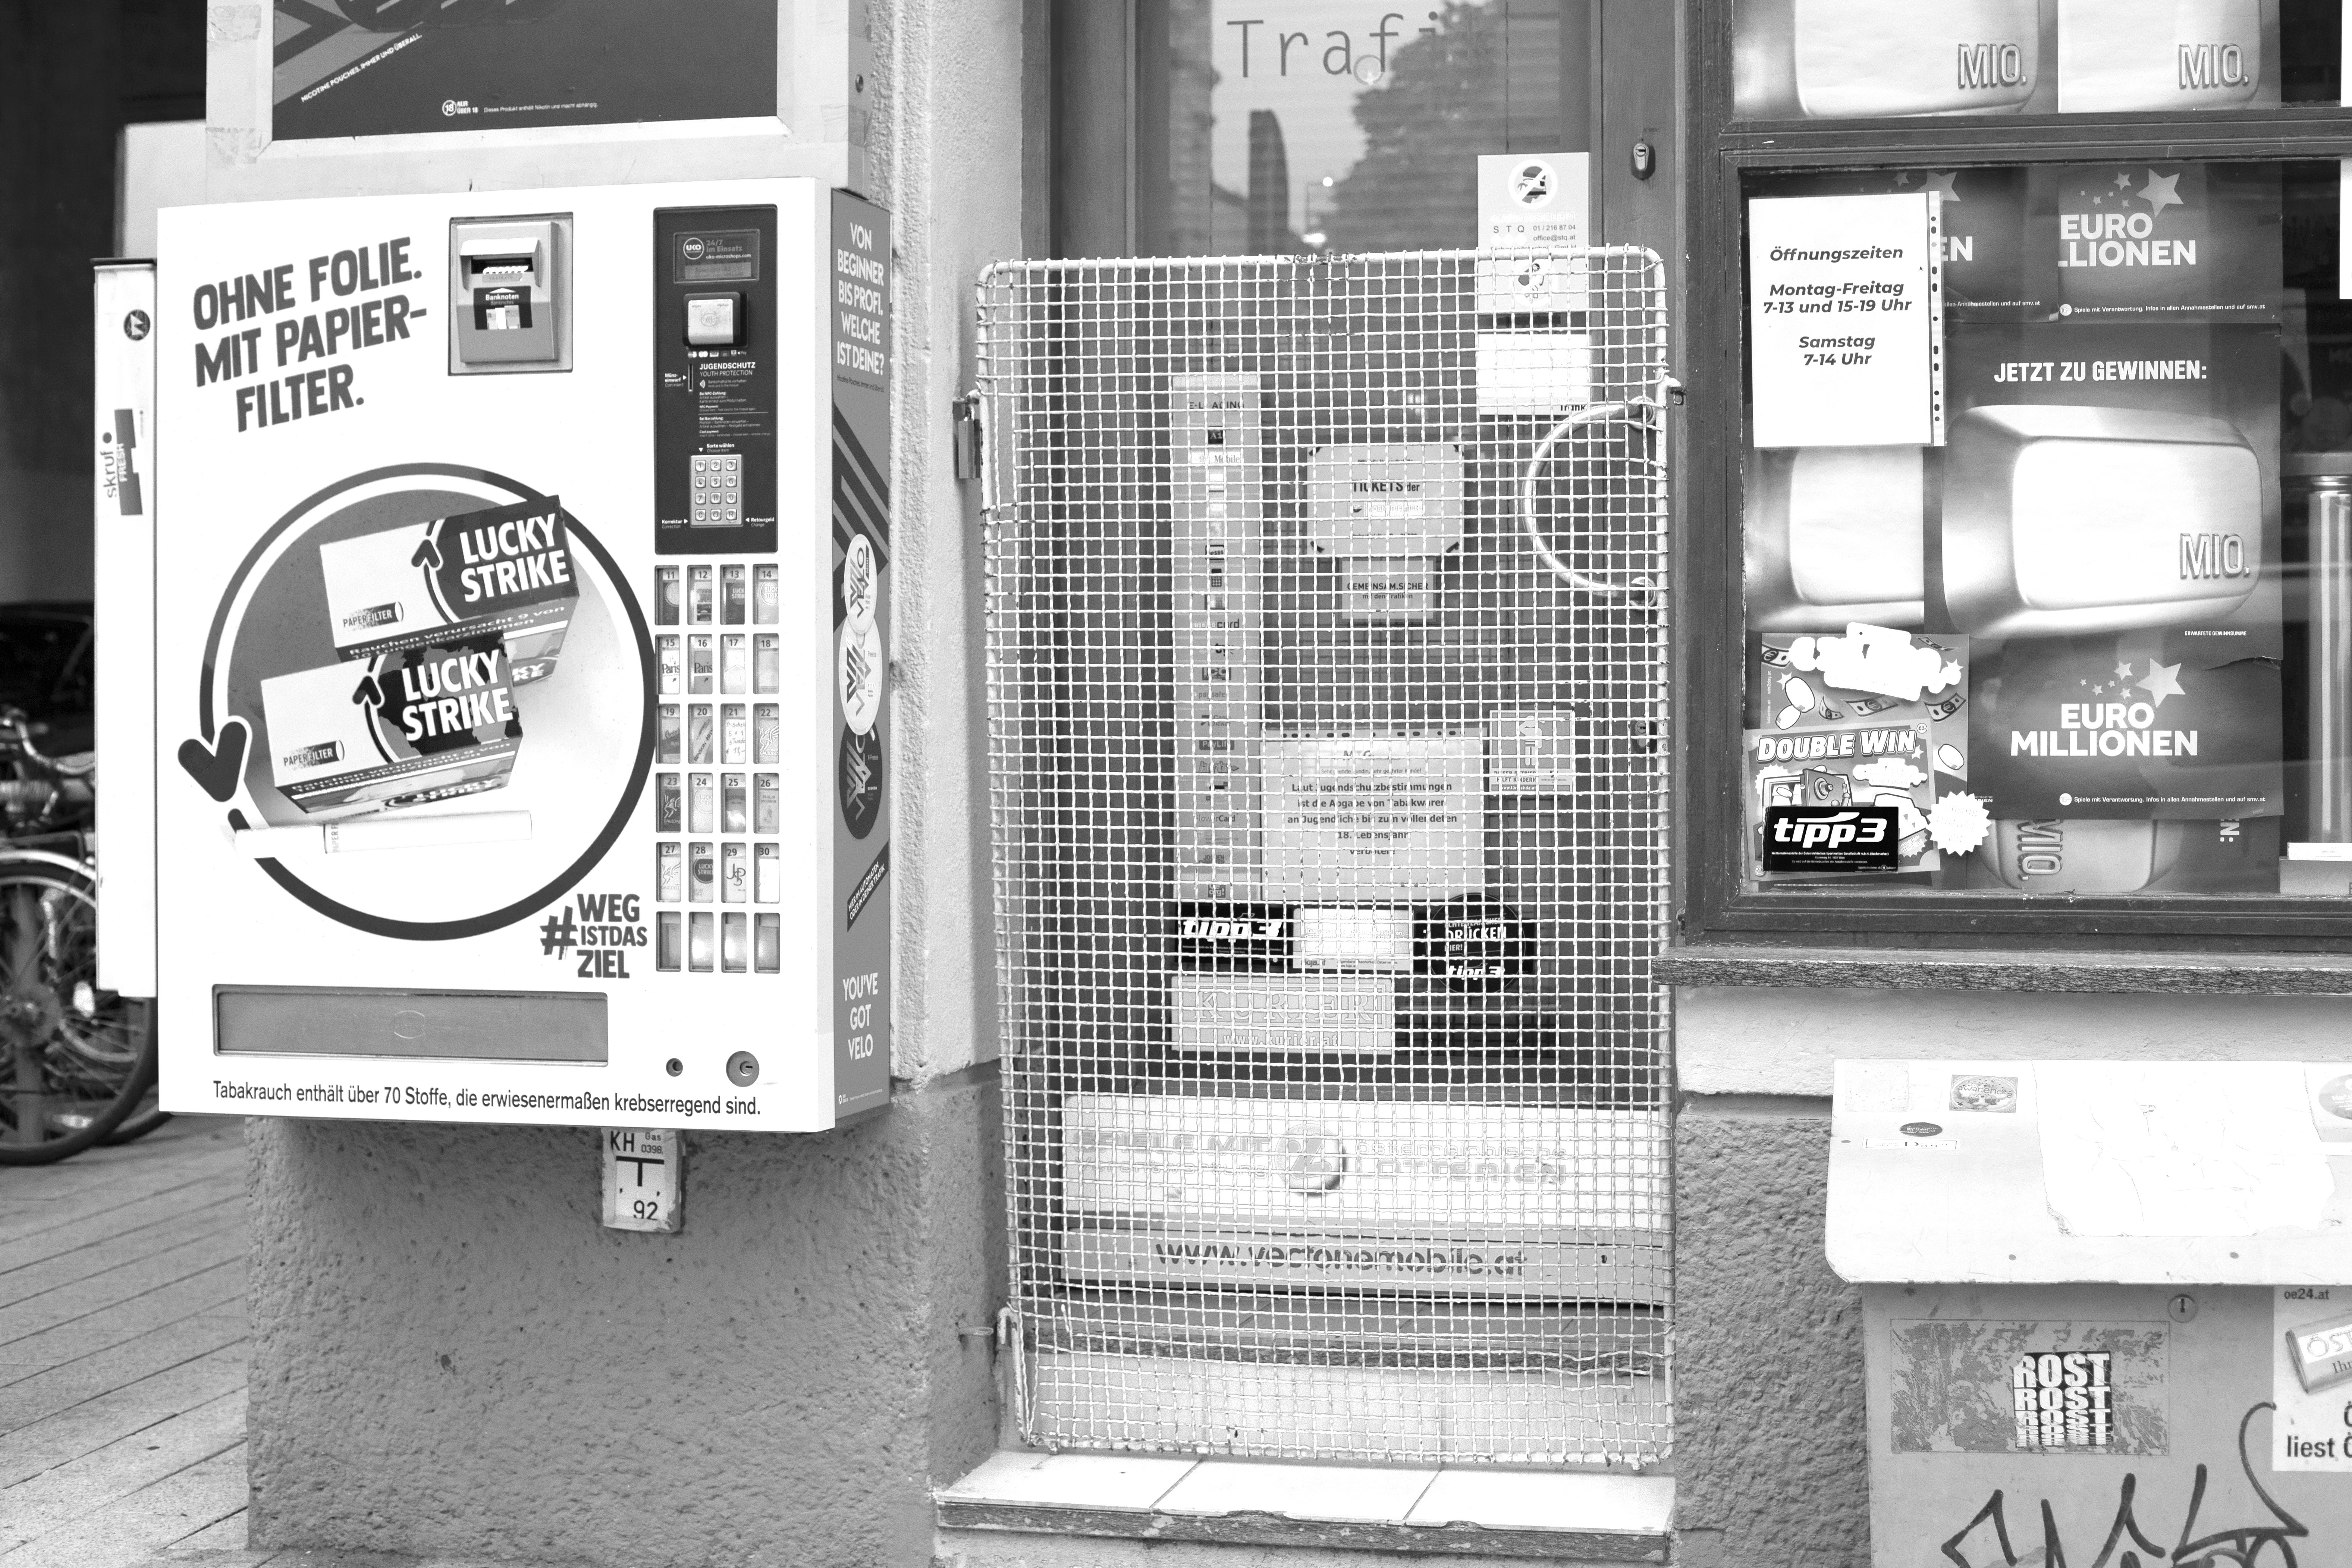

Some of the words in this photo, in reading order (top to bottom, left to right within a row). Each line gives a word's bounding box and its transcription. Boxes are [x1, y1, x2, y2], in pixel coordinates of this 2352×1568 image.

[301, 82, 330, 102] NICOTINE
[330, 66, 361, 86] POUCHES.
[360, 55, 380, 69] IMMER
[380, 47, 394, 58] UND
[394, 34, 422, 51] ÜBERALL.
[1957, 43, 2026, 88] MIO.
[2179, 43, 2249, 89] MIO.
[850, 222, 872, 252] VON
[2060, 213, 2153, 239] EURO
[838, 248, 884, 286] BEGINNER
[1770, 246, 1903, 263] Öffnungszeiten
[194, 264, 296, 330] OHNE
[309, 236, 422, 302] FOLIE.
[838, 280, 852, 305] BIS
[854, 285, 883, 315] PROFI.
[1770, 281, 1904, 298] Montag-Freitag
[1763, 301, 1793, 313] 7-13
[1799, 300, 1832, 312] und
[1838, 300, 1876, 312] 15-19
[1881, 299, 1912, 311] Uhr
[195, 327, 261, 387] MIT
[276, 295, 427, 367] PAPIER-
[841, 311, 880, 345] WELCHE
[1799, 336, 1875, 350] Samstag
[837, 341, 851, 366] IST
[852, 345, 885, 375] DEINE?
[1804, 353, 1836, 365] 7-14
[1841, 352, 1872, 365] Uhr
[1994, 362, 2055, 382] JETZT
[2060, 361, 2086, 381] ZU
[2092, 360, 2207, 381] GEWINNEN:
[236, 364, 364, 433] FILTER.
[459, 513, 555, 564] LUCKY
[2180, 532, 2249, 579] MIO.
[461, 550, 570, 602] STRIKE
[343, 609, 392, 628] PAPERFILTER
[349, 637, 419, 656] Rauchen
[423, 615, 514, 639] verursacht
[533, 606, 564, 616] von
[402, 649, 499, 701] LUCKY
[402, 688, 513, 741] STRIKE
[2061, 702, 2154, 729] EURO
[283, 748, 333, 766] PAPERFILTER
[1757, 735, 1856, 762] DOUBLE
[1860, 729, 1918, 755] WIN
[2011, 730, 2197, 756] MILLIONEN
[1774, 812, 1887, 848] tipp3
[860, 861, 879, 895] AUTOMATEN
[577, 893, 640, 923] WEG
[581, 925, 647, 946] ISTDAS
[577, 949, 629, 978] ZIEL
[842, 972, 878, 1001] YOU'VE
[850, 1004, 872, 1031] GOT
[848, 1034, 873, 1060] VELO
[213, 1080, 292, 1101] Tabakrauch
[296, 1084, 343, 1102] enthält
[348, 1085, 379, 1103] über
[384, 1087, 401, 1104] 70
[405, 1087, 451, 1109] Stoffe,
[456, 1088, 478, 1107] die
[482, 1090, 609, 1111] erwiesenermaßen
[614, 1093, 721, 1117] krebserregend
[725, 1096, 760, 1115] sind.
[610, 1131, 634, 1152] KH
[645, 1132, 661, 1141] Gas
[641, 1144, 662, 1154] 0398
[2284, 1288, 2329, 1300] oe24.at
[2013, 1353, 2109, 1388] ROST
[2014, 1386, 2111, 1410] ROST
[2287, 1434, 2335, 1458] liest
